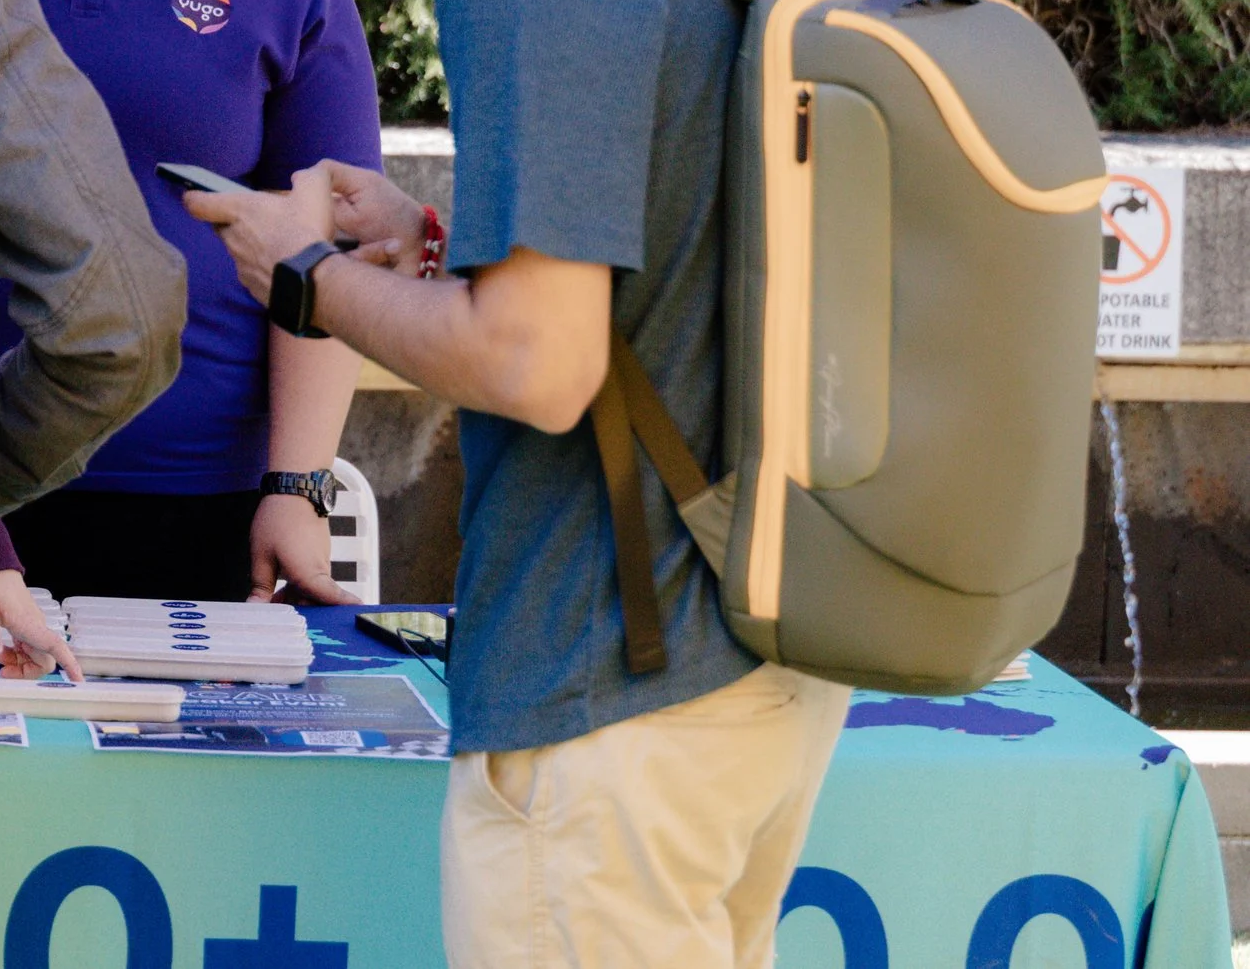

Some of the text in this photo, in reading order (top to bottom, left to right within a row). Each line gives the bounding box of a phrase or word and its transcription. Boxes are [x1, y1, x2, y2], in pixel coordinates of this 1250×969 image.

[1100, 293, 1170, 308] POTABLE
[1097, 314, 1141, 327] ATER
[1096, 334, 1172, 348] OT DRINK
